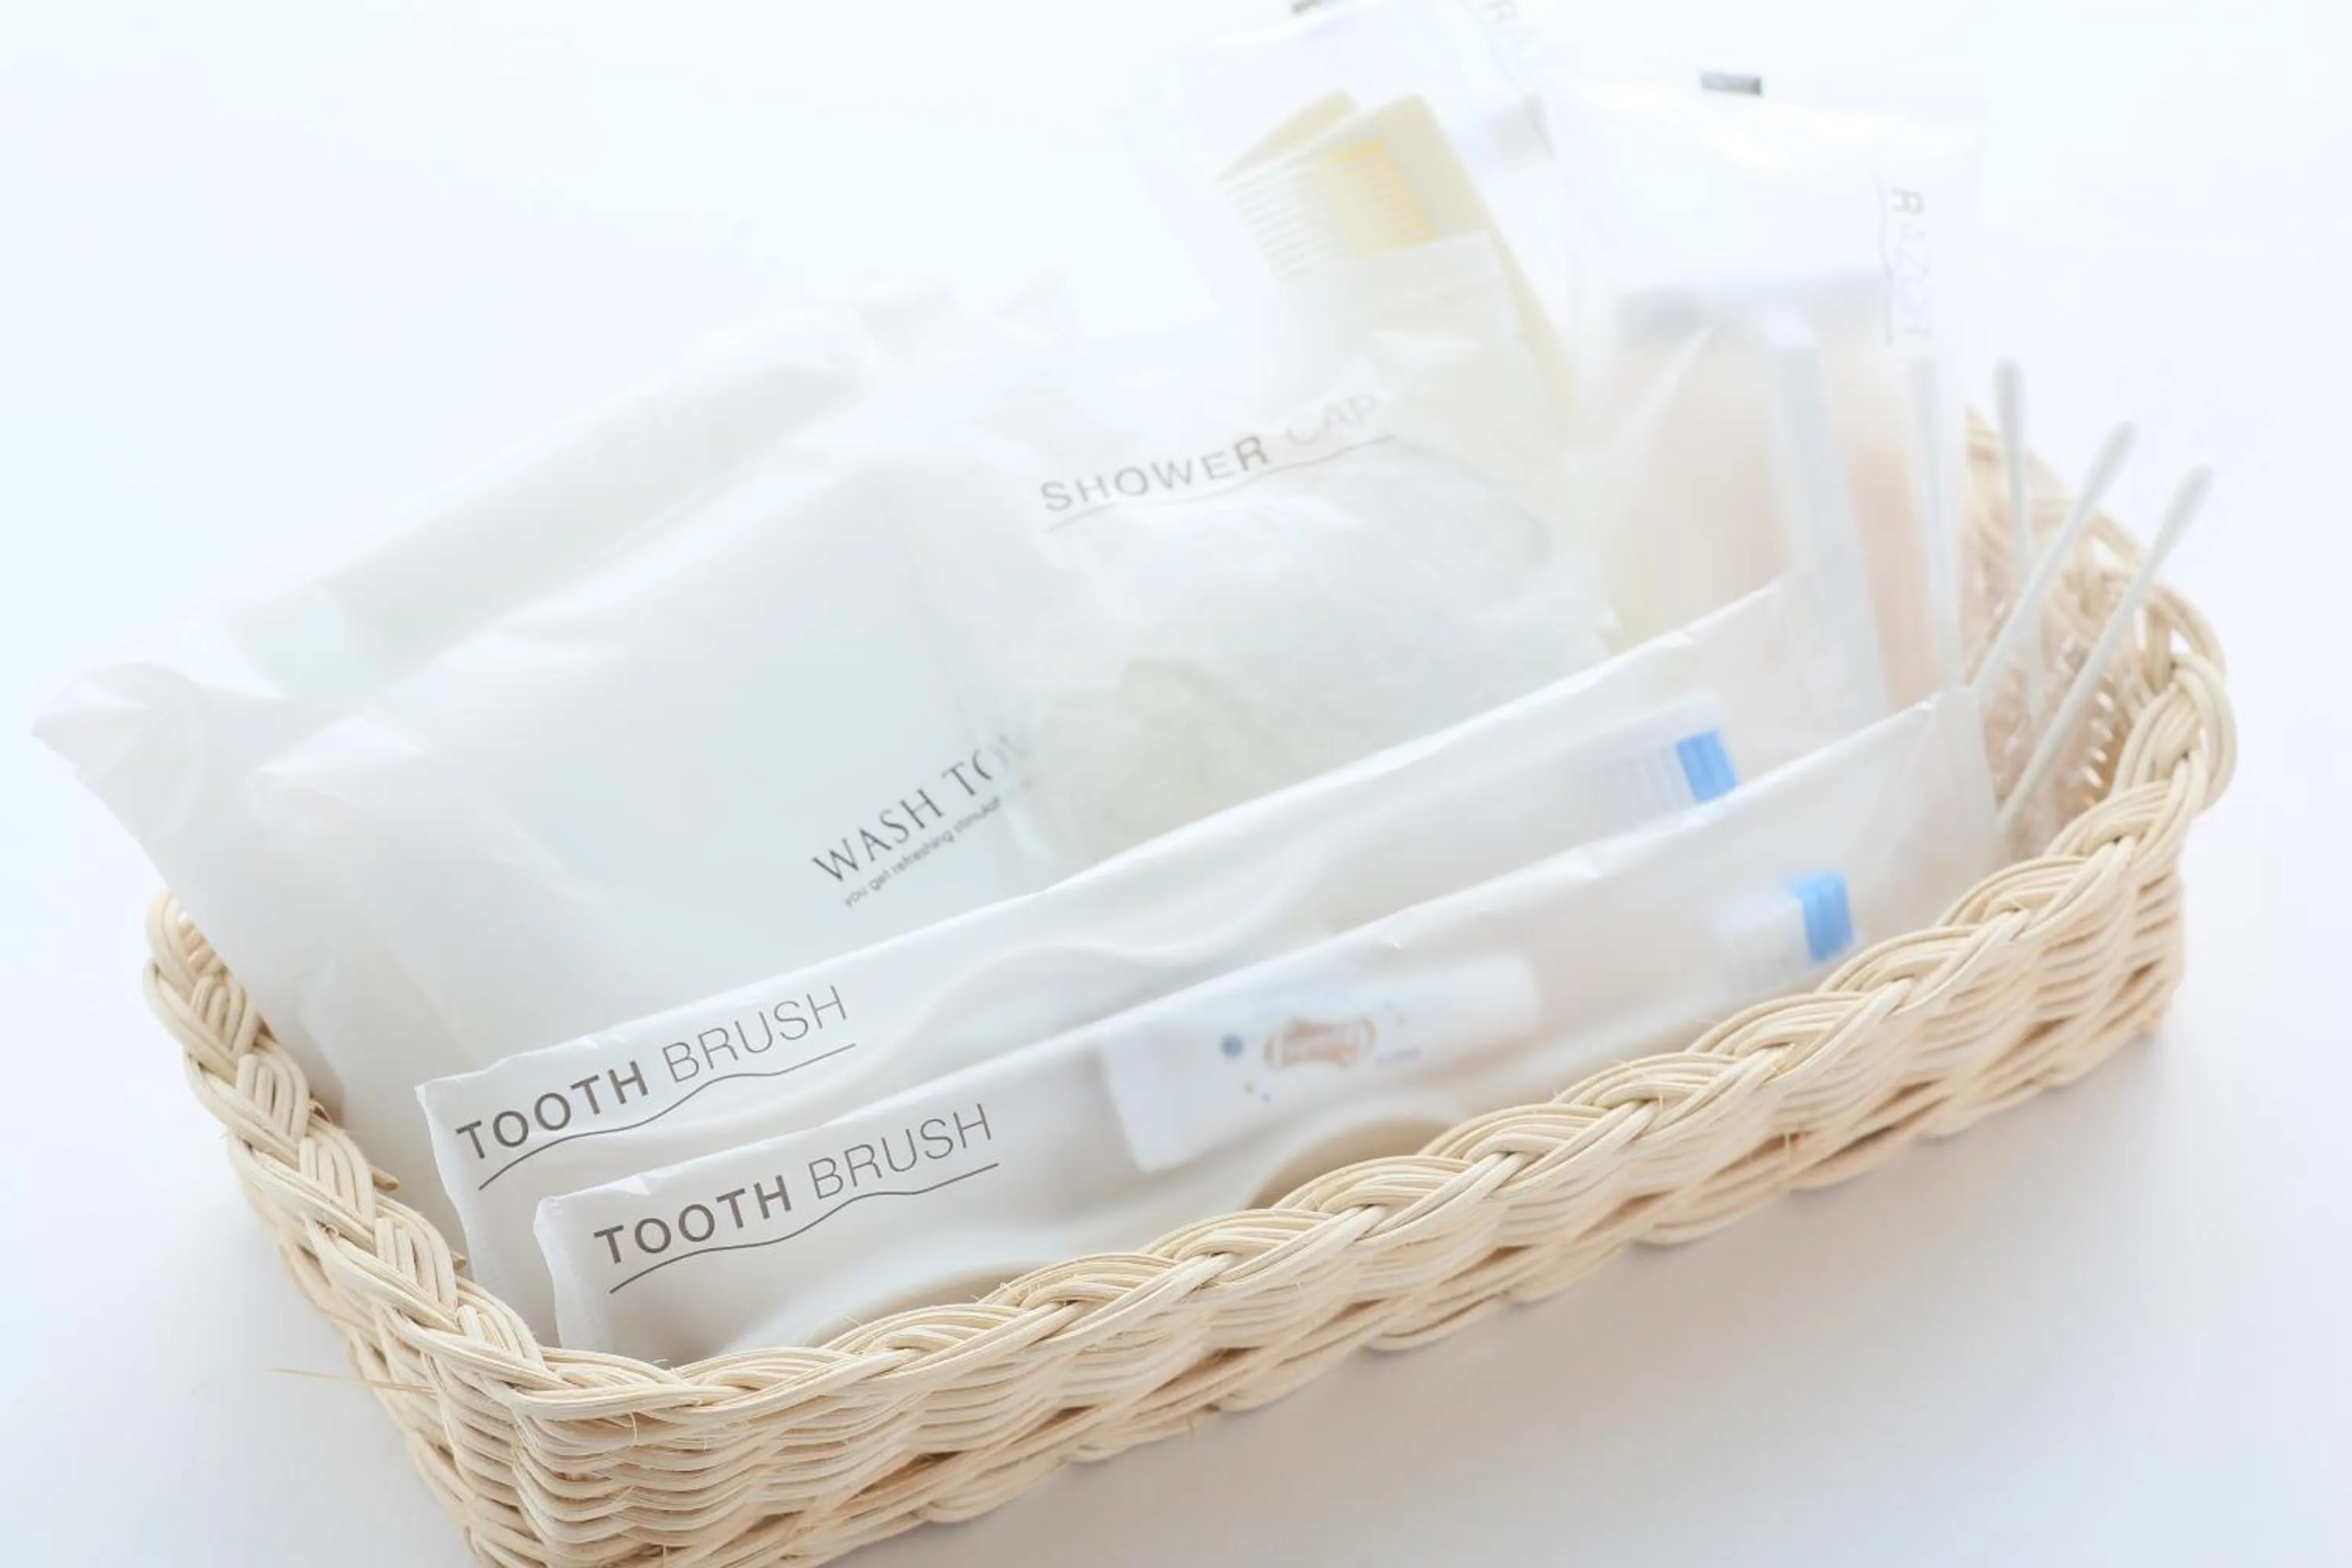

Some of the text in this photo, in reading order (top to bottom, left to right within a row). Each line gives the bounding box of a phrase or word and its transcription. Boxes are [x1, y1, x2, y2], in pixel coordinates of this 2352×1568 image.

[1040, 392, 1381, 512] SHOWER CAP
[811, 786, 945, 883] WASH
[844, 886, 869, 908] you
[867, 869, 892, 893] get
[891, 829, 955, 876] refreshing
[455, 984, 848, 1160] TOOTH BRUSH
[593, 1102, 993, 1265] TOOTH BRUSH
